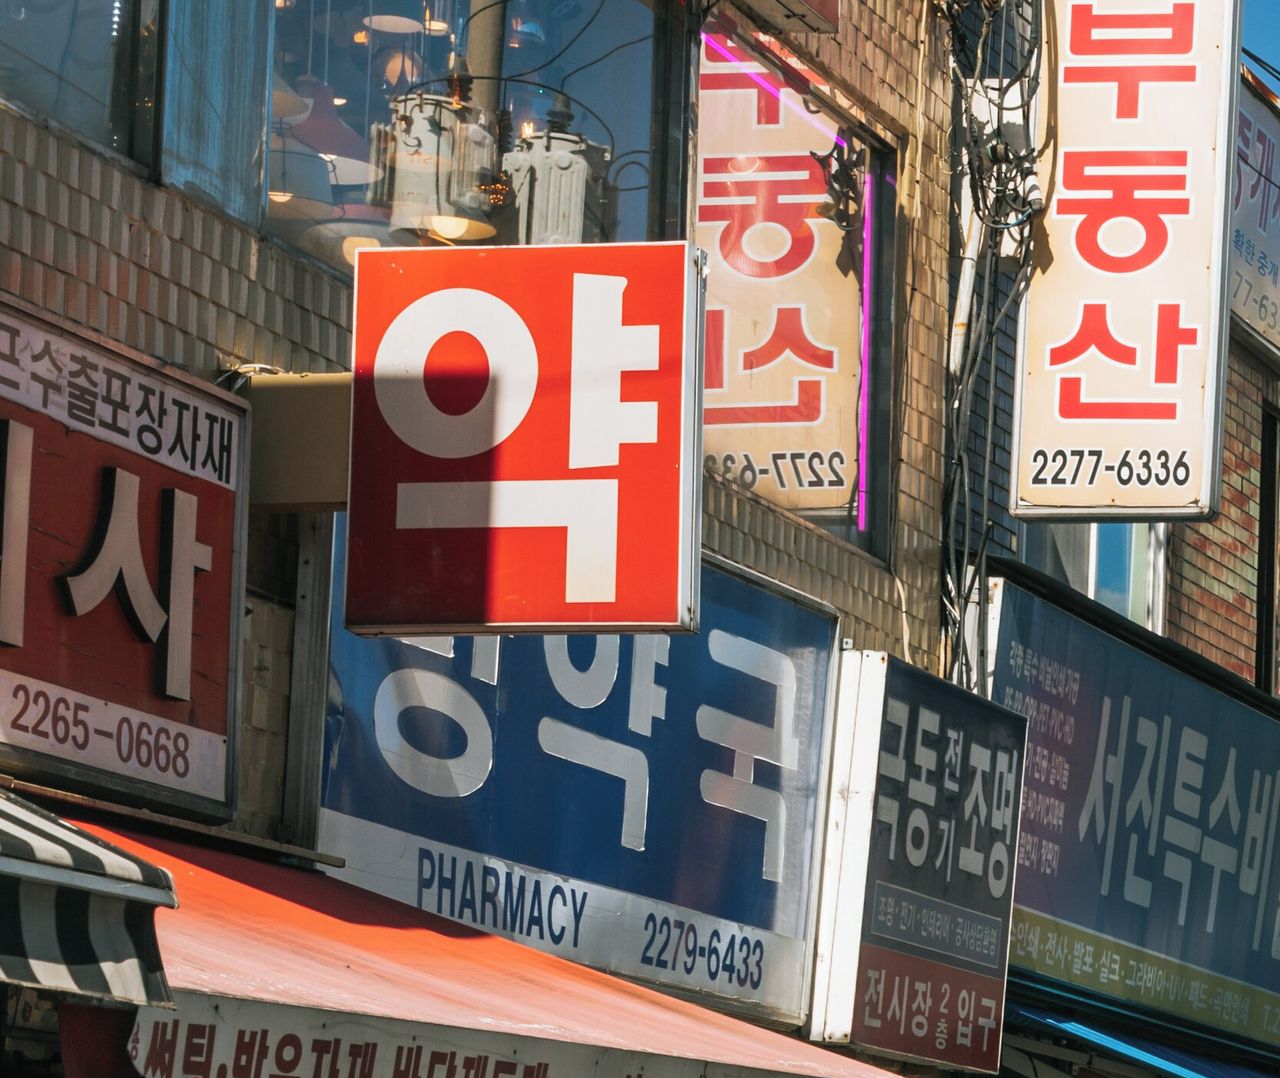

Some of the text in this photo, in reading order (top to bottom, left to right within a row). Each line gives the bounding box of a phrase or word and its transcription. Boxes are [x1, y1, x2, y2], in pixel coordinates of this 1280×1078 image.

[1049, 2, 1197, 420] 부동산
[374, 272, 660, 604] 약
[1031, 449, 1191, 487] 2277-6336
[10, 683, 191, 779] 2265-0668
[958, 741, 1019, 900] 조명
[417, 847, 588, 949] PHARMACY
[640, 912, 765, 991] 2279-6433
[864, 967, 933, 1038] 전시장
[956, 989, 997, 1052] 입구
